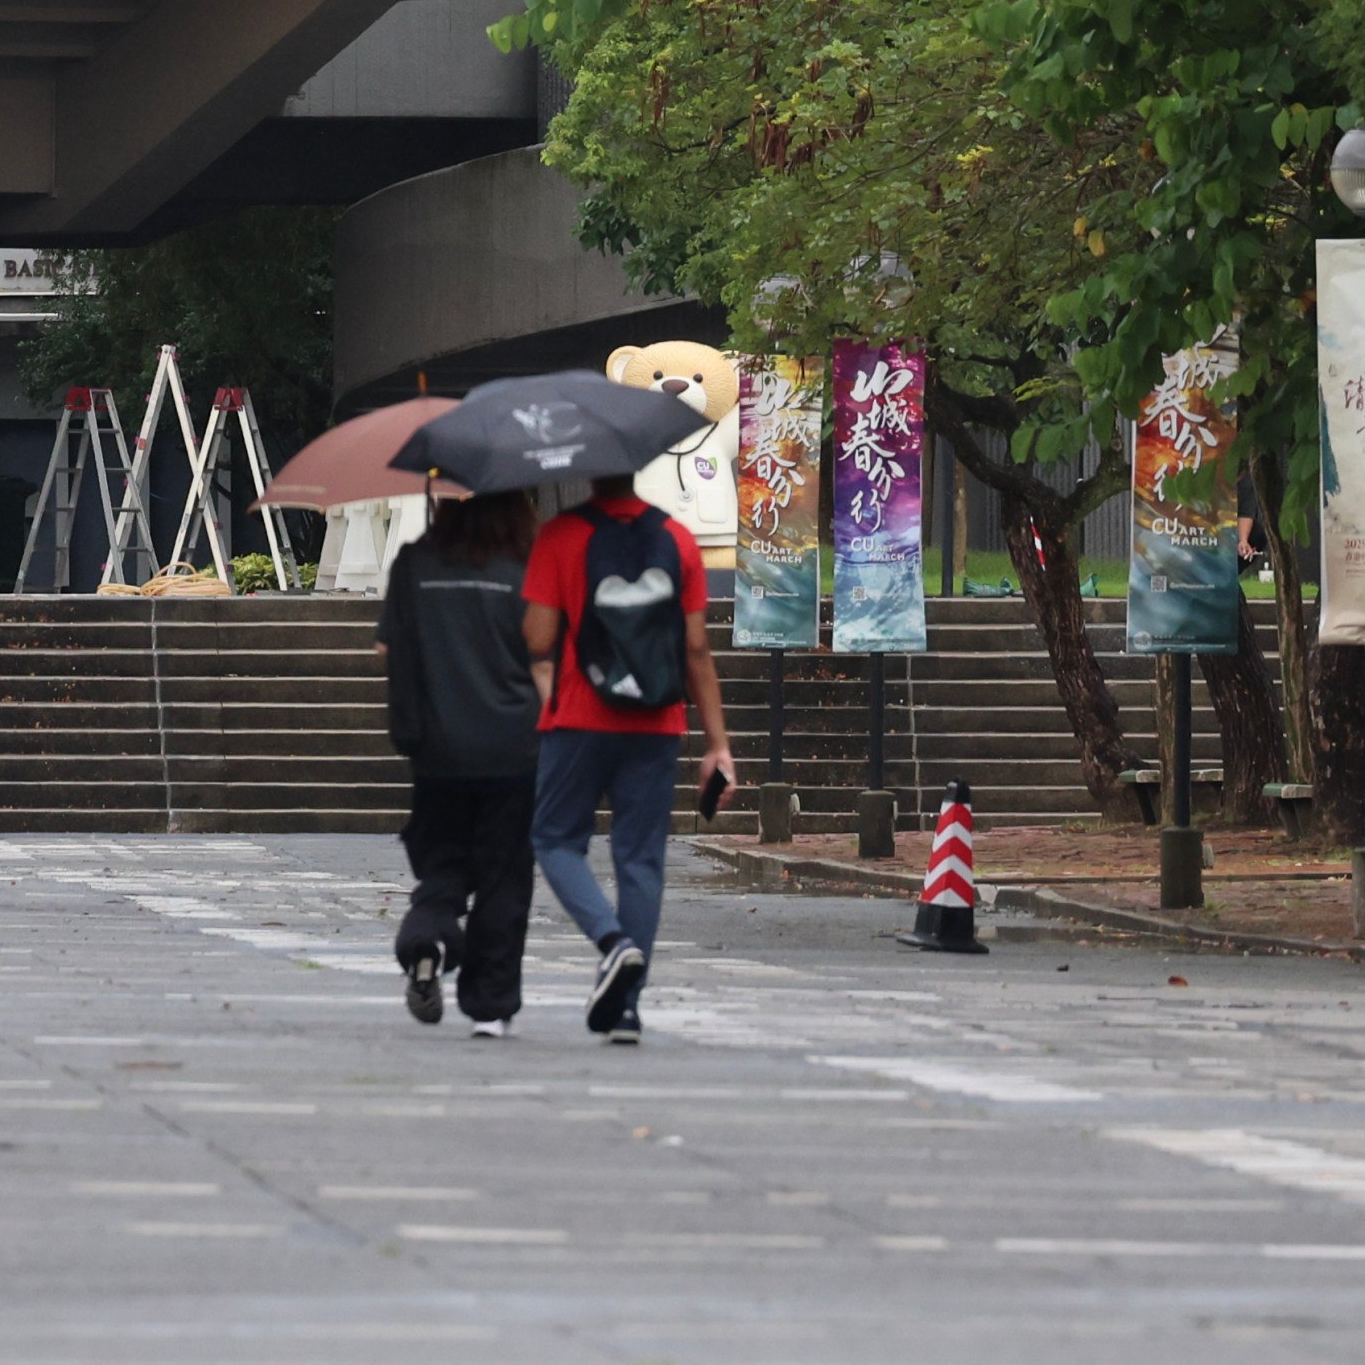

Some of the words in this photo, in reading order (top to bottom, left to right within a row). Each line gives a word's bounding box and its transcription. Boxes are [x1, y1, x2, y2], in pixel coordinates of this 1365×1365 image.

[1139, 323, 1227, 512] 城春分
[1151, 518, 1178, 535] CU
[1178, 526, 1205, 535] ART
[750, 540, 771, 554] CU
[772, 547, 791, 555] ART
[1171, 536, 1218, 546] MARCH
[766, 555, 802, 563] MARCH
